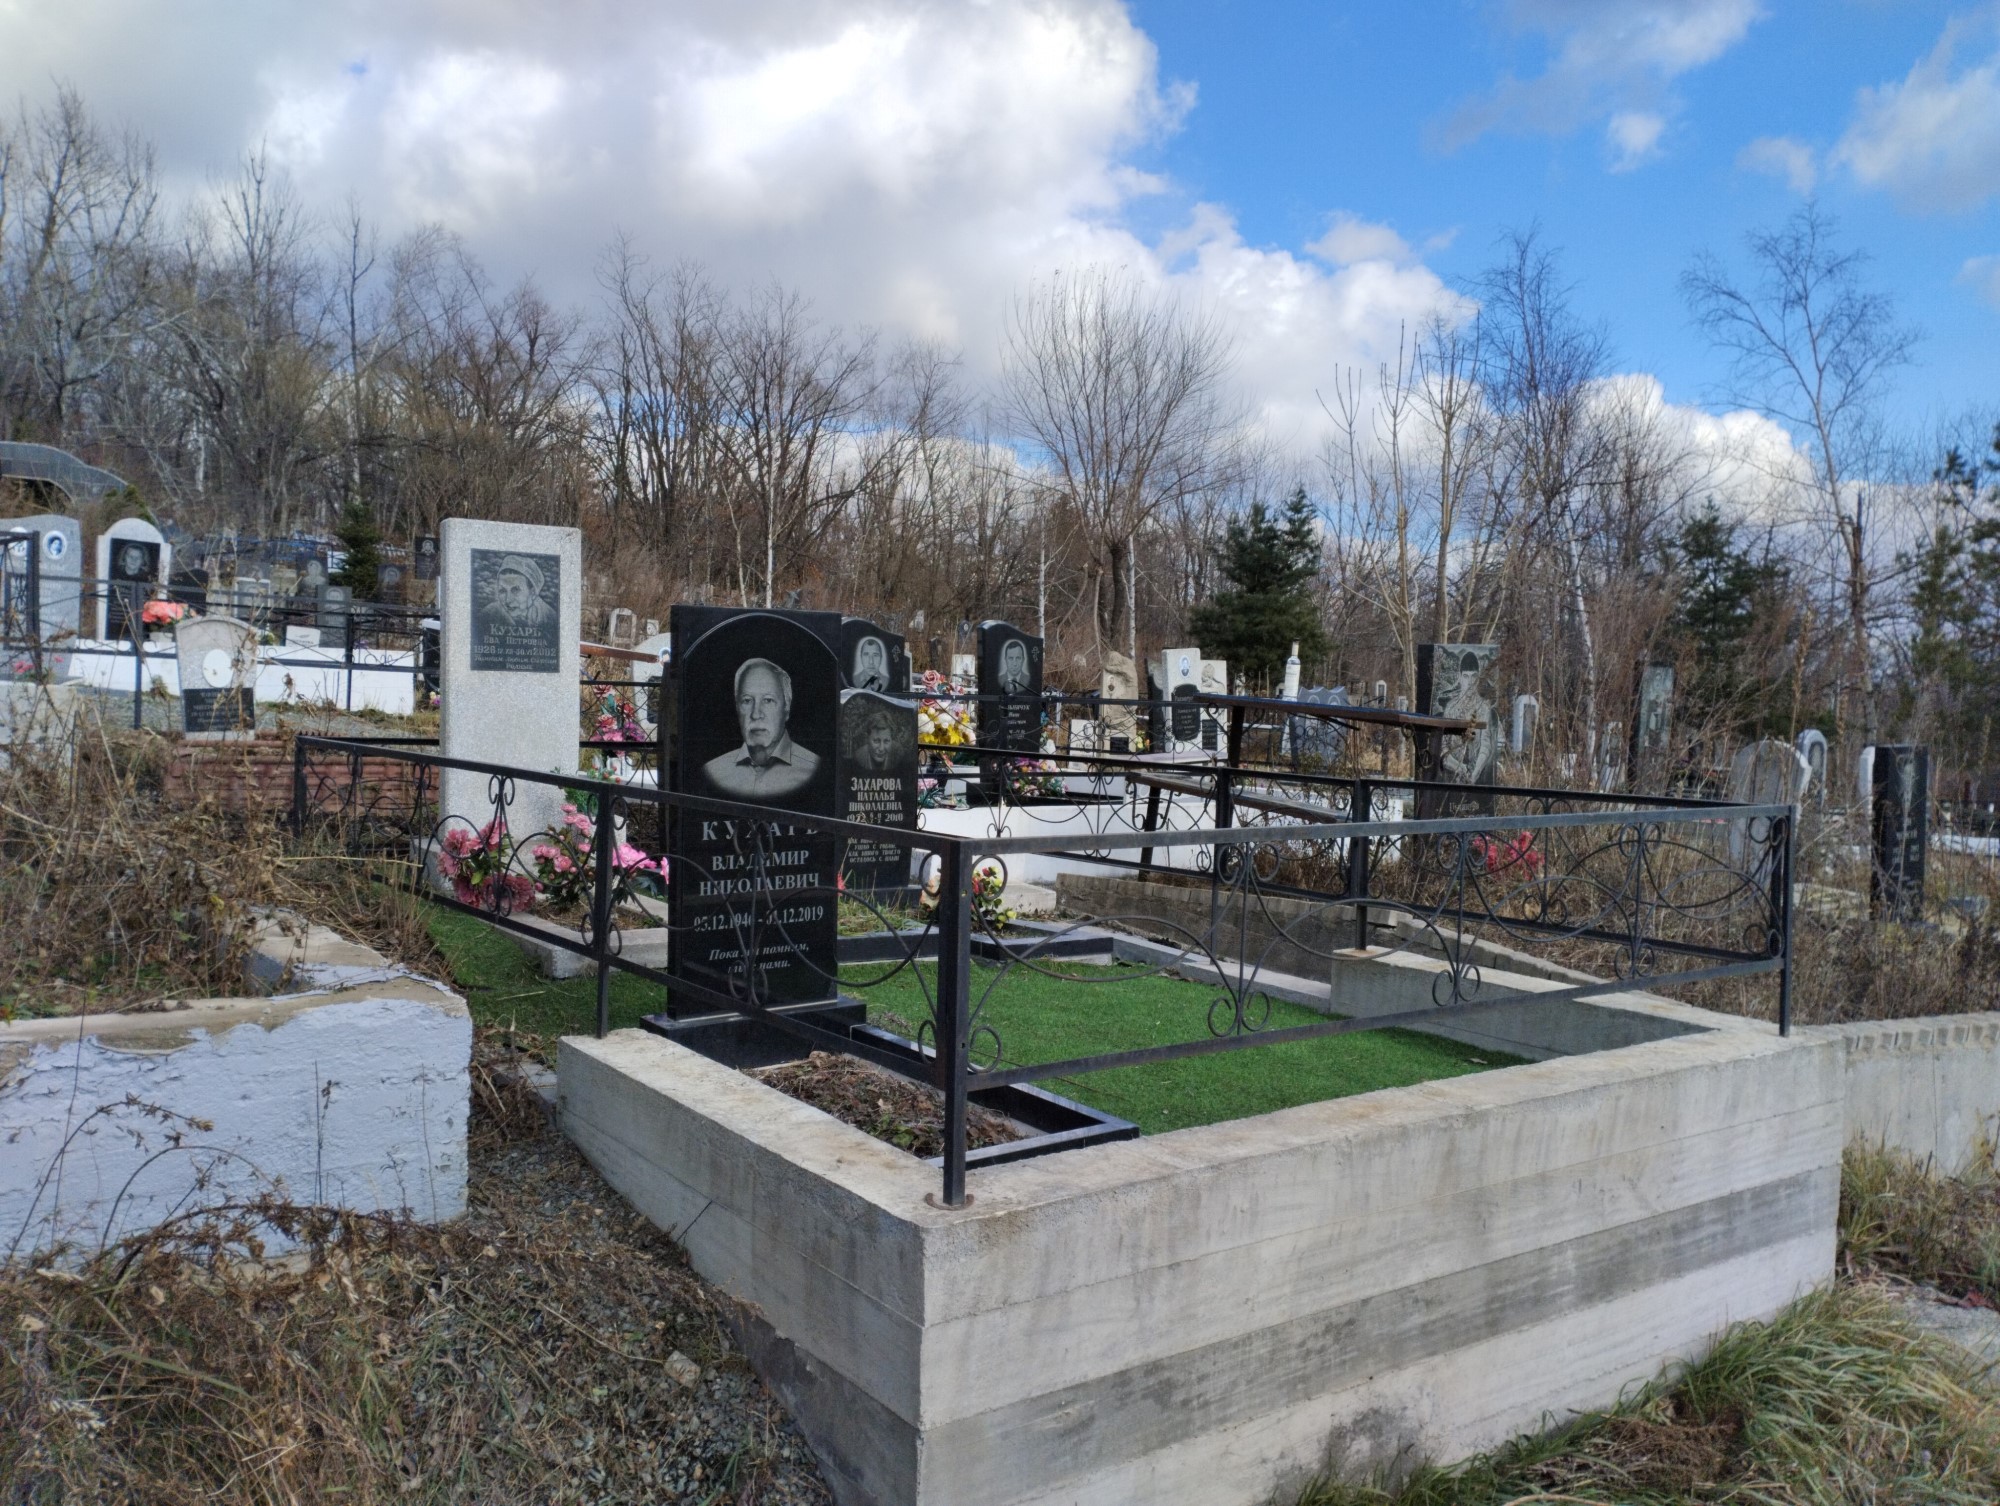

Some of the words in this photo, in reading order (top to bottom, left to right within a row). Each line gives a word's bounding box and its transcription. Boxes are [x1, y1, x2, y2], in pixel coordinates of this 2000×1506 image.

[851, 777, 902, 791] ЗАХАРОВА
[857, 791, 895, 801] НАТАЛЬЯ
[849, 801, 903, 812] НИКОЛАЕВНА
[885, 813, 904, 822] 2010
[709, 949, 739, 961] Пока
